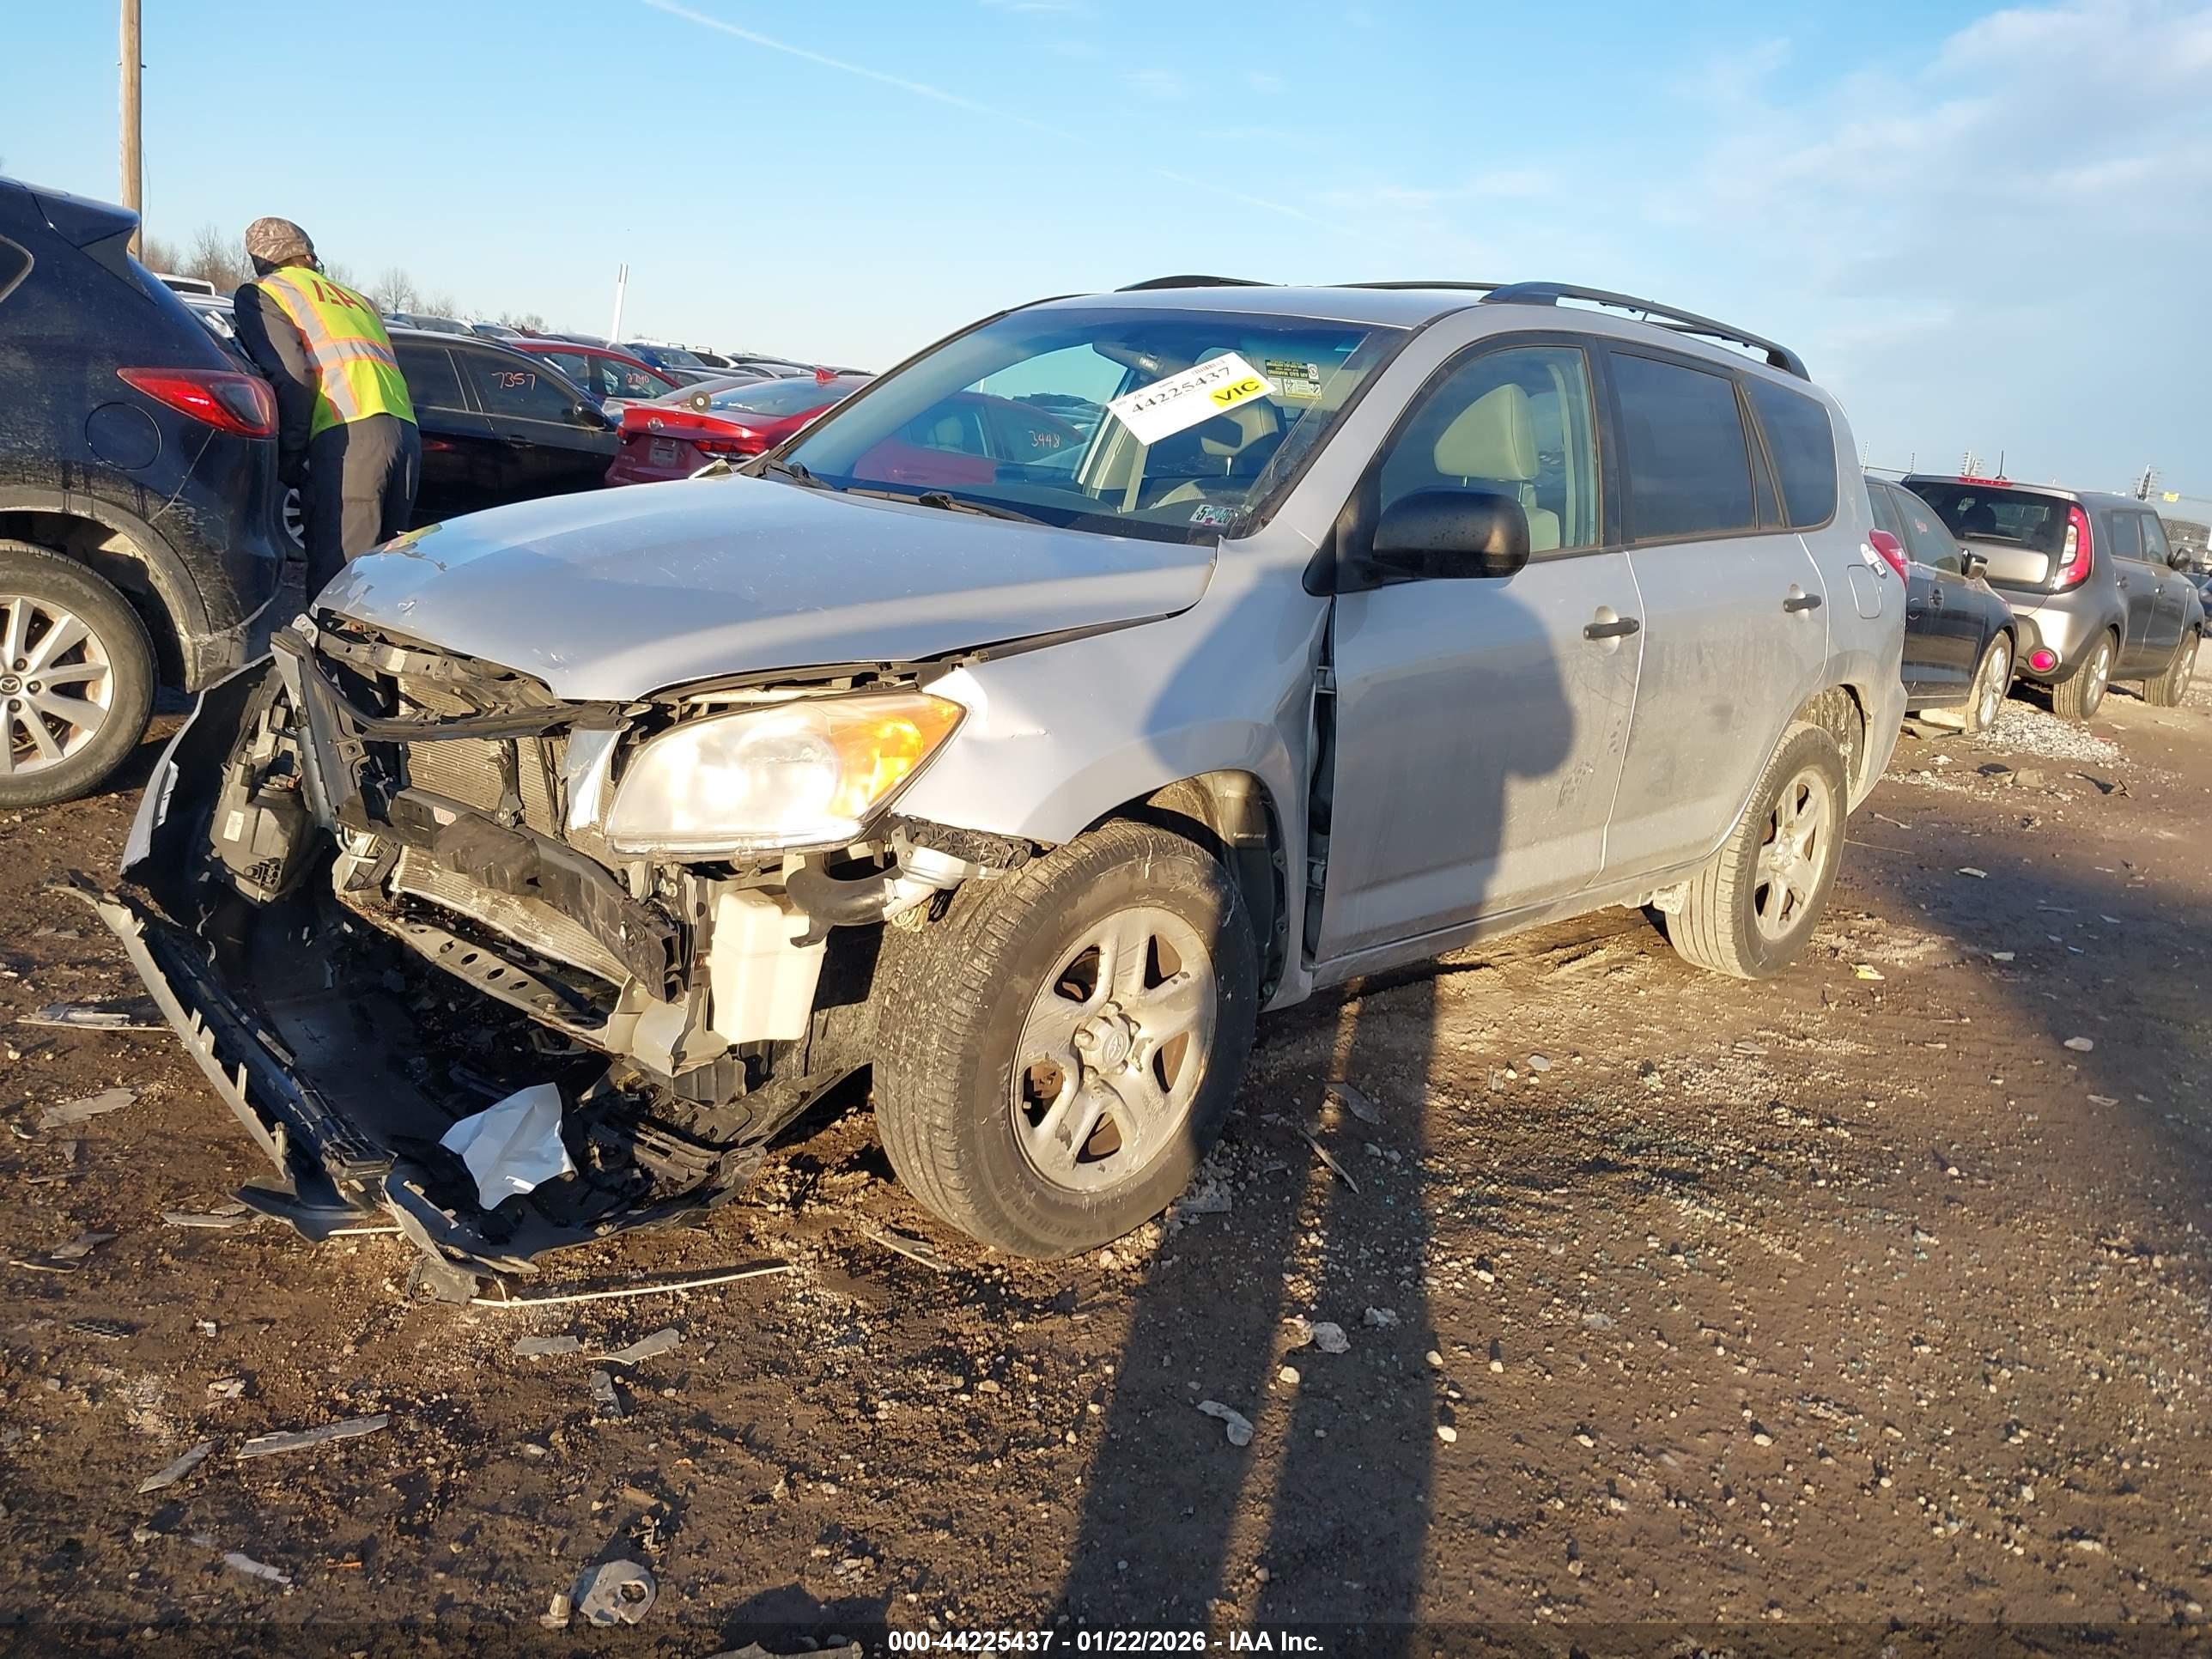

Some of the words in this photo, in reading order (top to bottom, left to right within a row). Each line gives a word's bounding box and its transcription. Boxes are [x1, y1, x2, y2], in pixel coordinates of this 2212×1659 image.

[490, 371, 536, 391] 7357
[1133, 367, 1230, 412] 44225437
[1214, 381, 1259, 401] VIC
